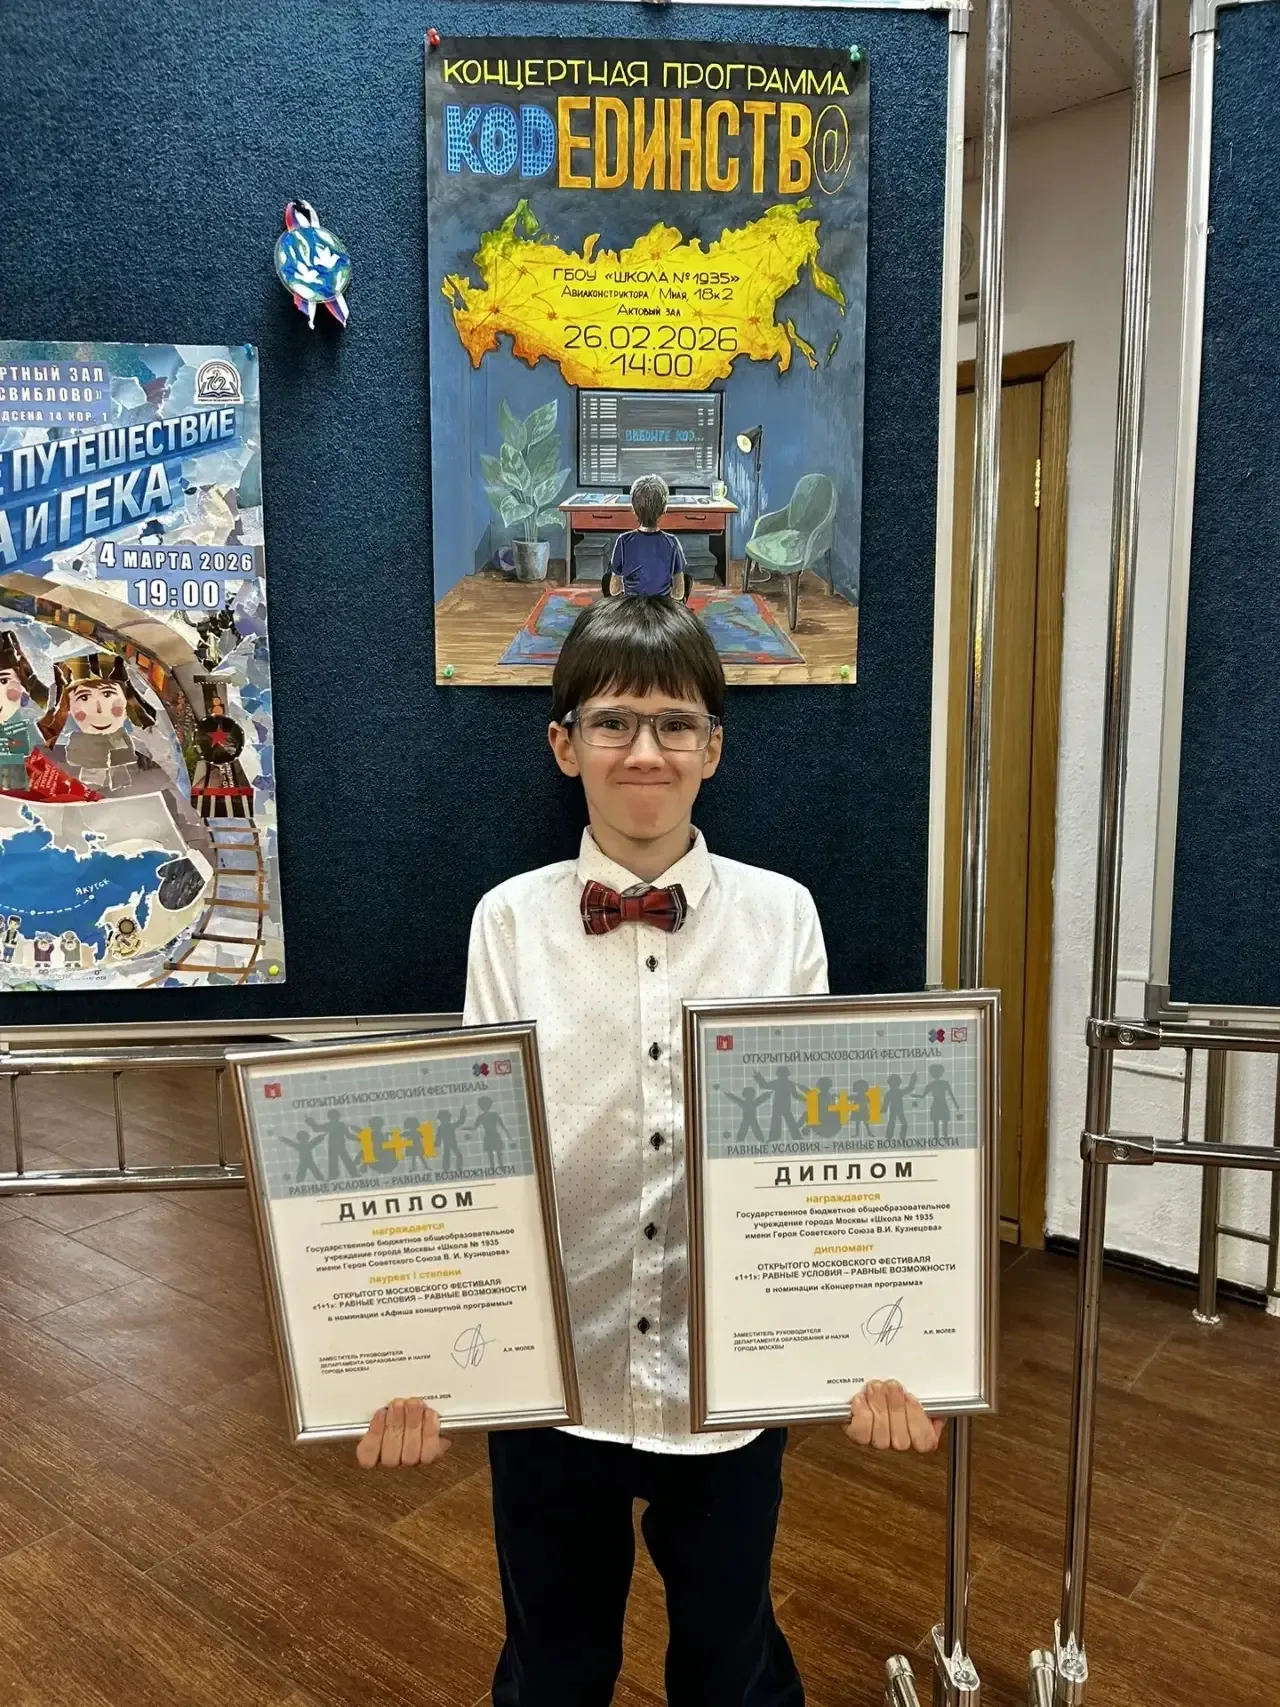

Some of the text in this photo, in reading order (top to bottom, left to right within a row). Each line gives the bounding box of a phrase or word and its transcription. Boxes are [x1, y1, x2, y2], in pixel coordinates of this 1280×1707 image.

[443, 60, 850, 96] КОНЦЕРТНАЯ ПРОГРАММА
[553, 268, 597, 282] ГБОУ
[605, 271, 669, 284] «ШКОЛА
[693, 272, 740, 285] 1935»
[564, 325, 737, 351] 26.02.2026
[69, 367, 104, 382] ЗАЛ
[610, 353, 693, 377] 14:00
[49, 411, 62, 422] 14
[102, 412, 108, 422] 1
[13, 408, 235, 492] ПУТЕШЕСТВИЕ
[25, 501, 49, 550] И
[59, 463, 172, 543] ГЕКА
[99, 542, 252, 572] 4 МАРТА 2026
[134, 579, 219, 607] 19:00
[742, 1047, 943, 1065] ОТКРЫТЫЙ МОСКОВСКИЙ ФЕСТИВАЛЬ
[292, 1080, 489, 1109] ОТКРЫТЫЙ МОСКОВСКИЙ ФЕСТИВАЛЬ
[804, 1085, 884, 1127] 1+1
[358, 1120, 438, 1165] 1+1
[727, 1143, 769, 1157] РАВНЫЕ
[771, 1141, 821, 1155] УСЛОВИЯ
[832, 1139, 875, 1151] РАВНЫЕ
[876, 1135, 960, 1150] ВОЗМОЖНОСТИ
[288, 1180, 330, 1196] РАВНЫЕ
[332, 1176, 380, 1191] УСЛОВИЯ
[392, 1172, 433, 1186] РАВНЫЕ
[434, 1165, 516, 1182] ВОЗМОЖНОСТИ
[774, 1162, 913, 1186] ДИПЛОМ
[339, 1191, 474, 1221] ДИПЛОМ
[806, 1193, 881, 1204] награждается
[736, 1203, 950, 1219] Государственное бюджетное общеобразовательное
[372, 1223, 444, 1236] награждается
[753, 1220, 803, 1230] учреждение
[805, 1218, 834, 1227] города
[836, 1217, 868, 1225] Москвы
[870, 1215, 902, 1223] «Школа
[773, 1231, 797, 1239] Героя
[799, 1229, 846, 1238] Советского
[848, 1227, 875, 1235] Союза
[895, 1225, 942, 1235] Кузнецова»
[306, 1228, 515, 1253] Государственное бюджетное общеобразовательное
[324, 1251, 372, 1262] учреждение
[404, 1246, 435, 1254] Москвы
[437, 1242, 468, 1251] «Школа
[481, 1239, 499, 1247] 1935
[814, 1244, 873, 1255] дипломант
[316, 1264, 341, 1272] имени
[343, 1262, 366, 1271] Героя
[369, 1258, 414, 1267] Советского
[416, 1255, 441, 1263] Союза
[464, 1249, 510, 1259] Кузнецова»
[757, 1255, 931, 1271] ОТКРЫТОГО МОСКОВСКОГО ФЕСТИВАЛЯ
[369, 1273, 410, 1284] лауреат
[420, 1269, 462, 1279] степени
[762, 1271, 799, 1280] РАВНЫЕ
[801, 1269, 842, 1278] УСЛОВИЯ
[851, 1267, 888, 1276] РАВНЫЕ
[890, 1264, 956, 1274] ВОЗМОЖНОСТИ
[333, 1278, 501, 1300] ОТКРЫТОГО МОСКОВСКОГО ФЕСТИВАЛЯ
[339, 1298, 375, 1308] РАВНЫЕ
[376, 1294, 416, 1305] УСЛОВИЯ
[425, 1290, 460, 1300] РАВНЫЕ
[462, 1285, 527, 1297] ВОЗМОЖНОСТИ
[773, 1284, 818, 1293] номинации
[820, 1282, 872, 1291] «Концертная
[875, 1280, 923, 1289] программа»
[335, 1312, 379, 1322] номинации
[381, 1308, 413, 1317] «Афиша
[415, 1304, 461, 1314] концертной
[776, 1328, 821, 1336] РУКОВОДИТЕЛЯ
[319, 1350, 403, 1362] ЗАМЕСТИТЕЛЬ РУКОВОДИТЕЛЯ
[320, 1360, 364, 1369] ДЕПАРТАМЕНТА
[366, 1357, 406, 1365] ОБРАЗОВАНИЯ
